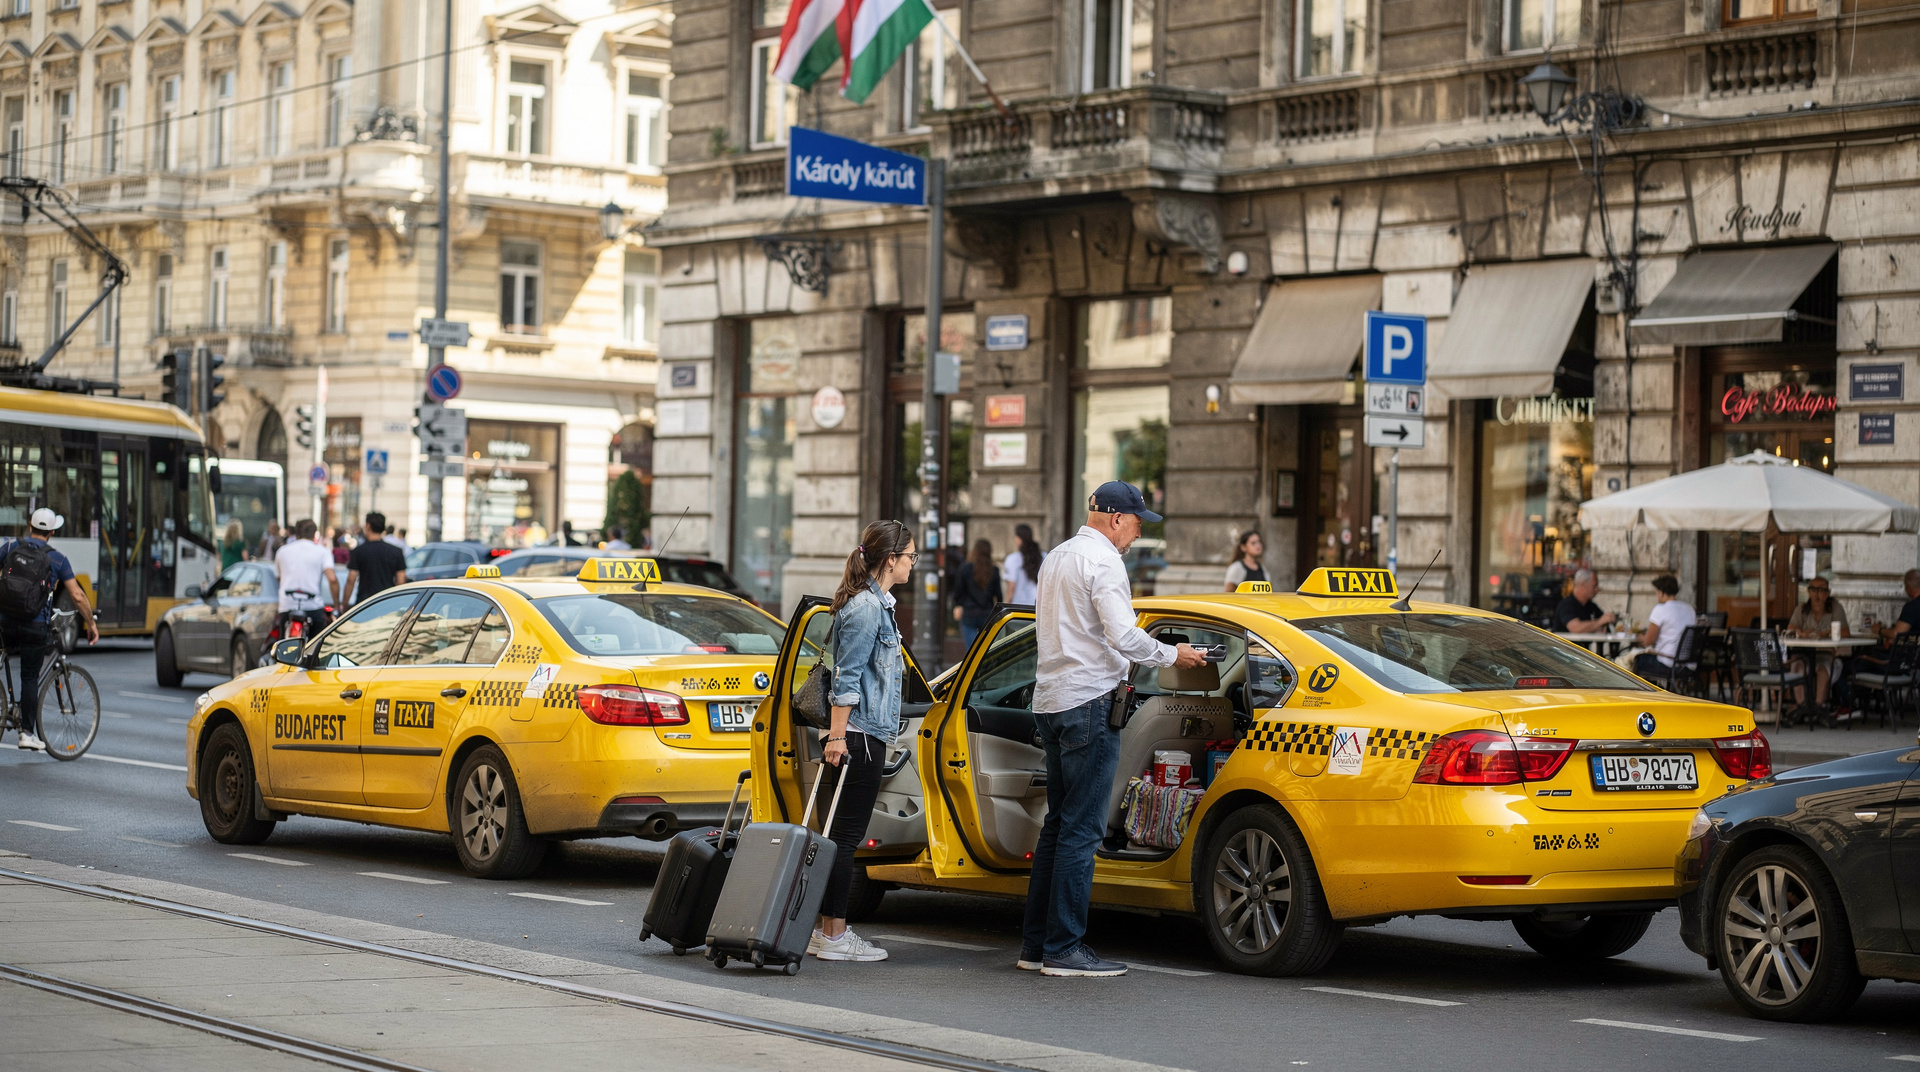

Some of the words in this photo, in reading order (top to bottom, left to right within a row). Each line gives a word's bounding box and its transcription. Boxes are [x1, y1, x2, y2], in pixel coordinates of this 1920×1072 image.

[796, 155, 861, 191] Károly
[1382, 324, 1413, 375] P
[600, 562, 652, 579] TAXI
[1332, 572, 1386, 592] TAXI
[275, 713, 346, 741] BUDAPEST
[397, 702, 430, 726] TAXI
